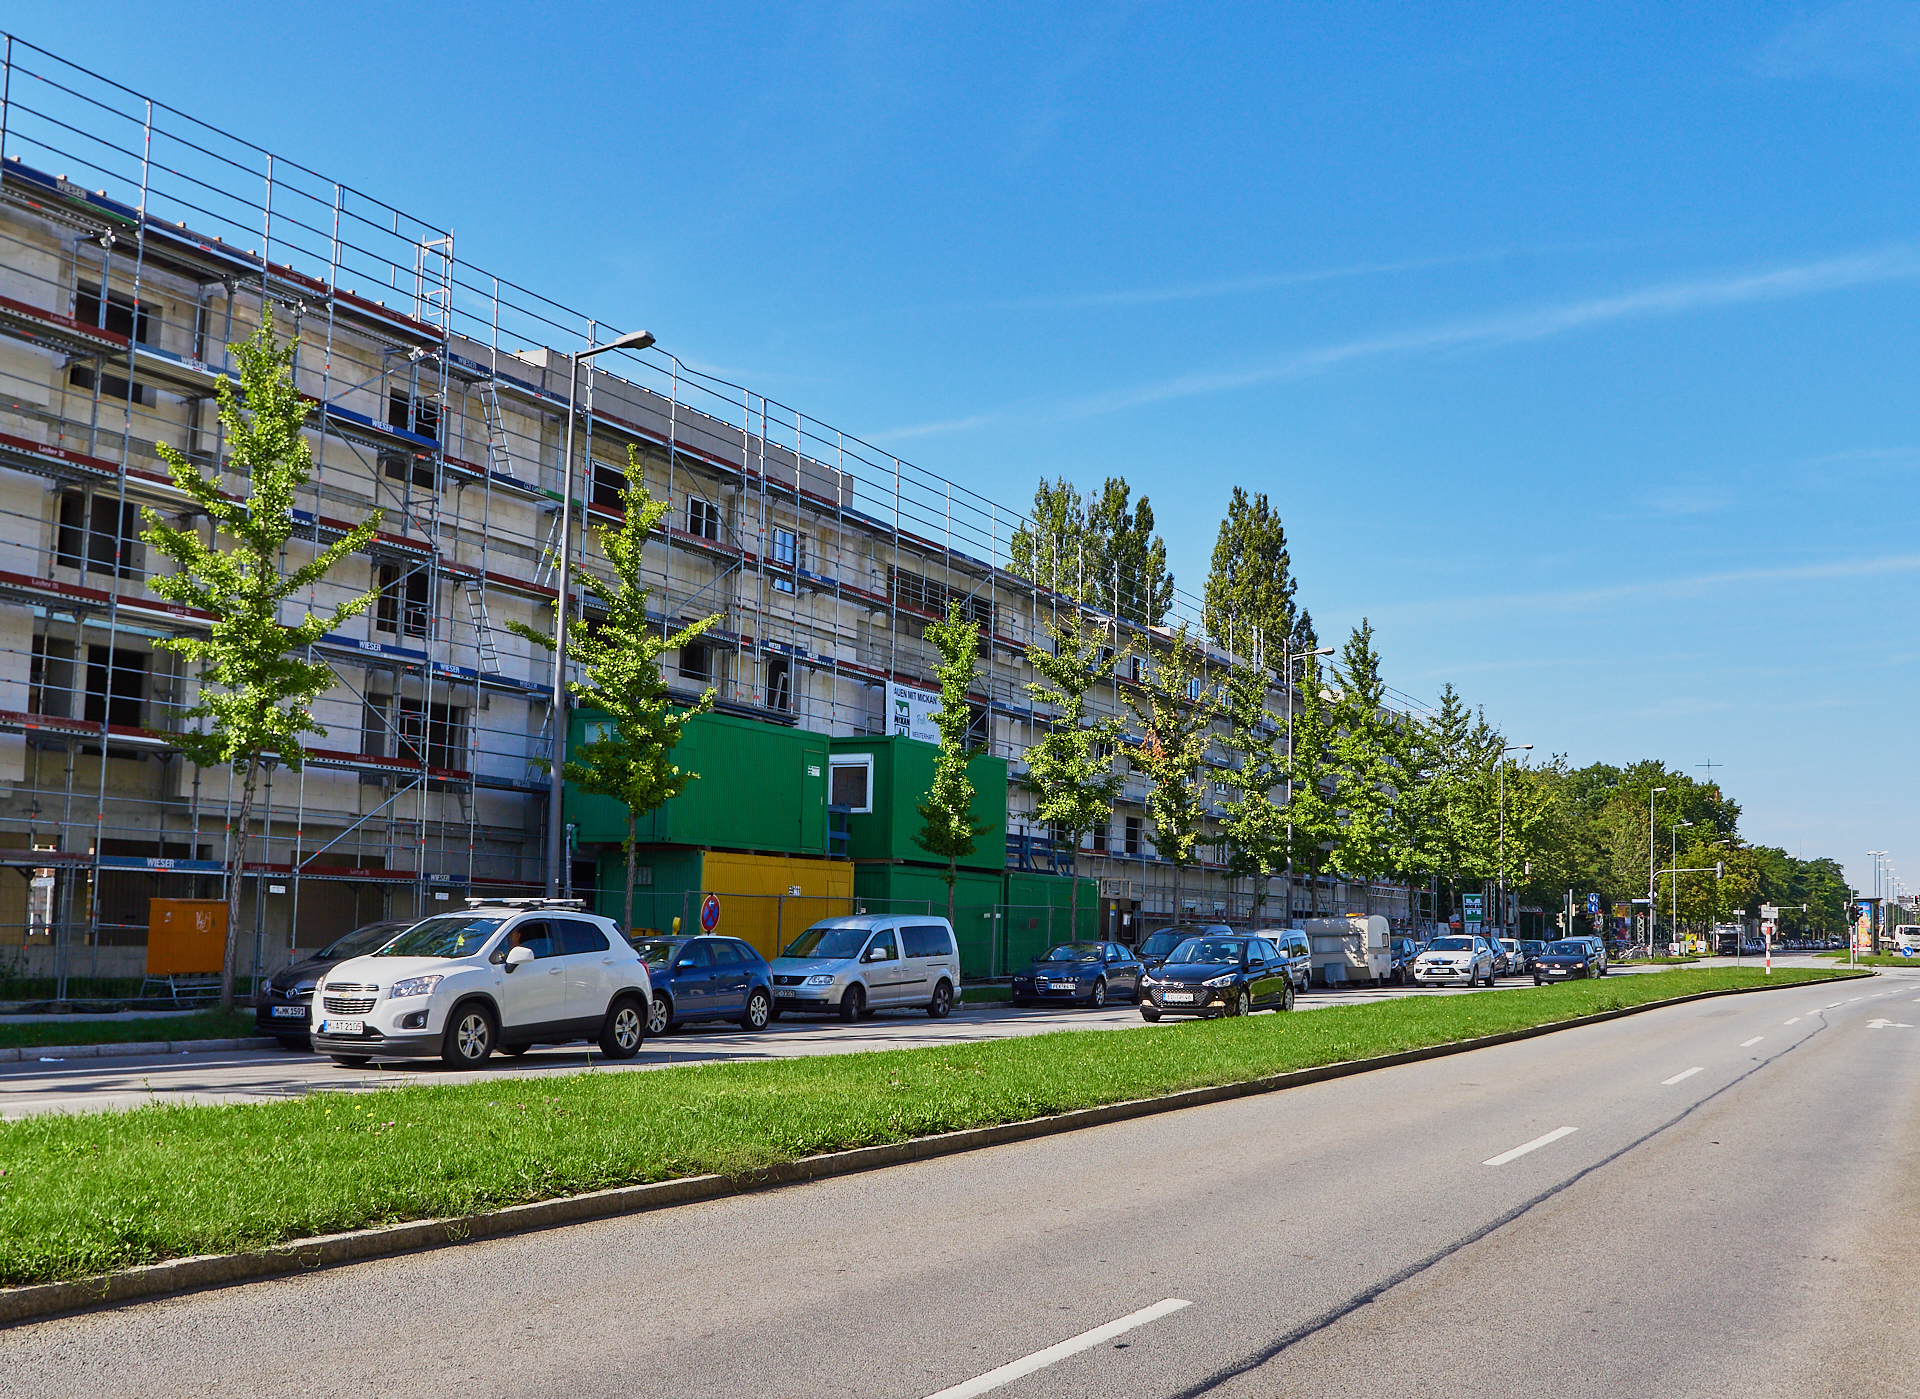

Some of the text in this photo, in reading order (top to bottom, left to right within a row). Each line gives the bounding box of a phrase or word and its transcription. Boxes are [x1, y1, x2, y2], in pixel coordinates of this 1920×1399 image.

[56, 178, 87, 200] WIESER
[181, 356, 208, 371] WIESER
[458, 356, 478, 370] WIESER
[372, 419, 394, 433] WIESER
[38, 444, 58, 457] Layher
[31, 578, 52, 590] Layher
[359, 640, 381, 652] WIESER
[440, 662, 460, 674] WIESER
[519, 680, 538, 691] WIESER
[908, 691, 916, 700] MIT
[917, 693, 937, 705] MICKAN
[147, 858, 175, 869] WIESER
[430, 873, 451, 882] WIESER
[326, 1021, 332, 1030] M
[336, 1021, 344, 1030] AT
